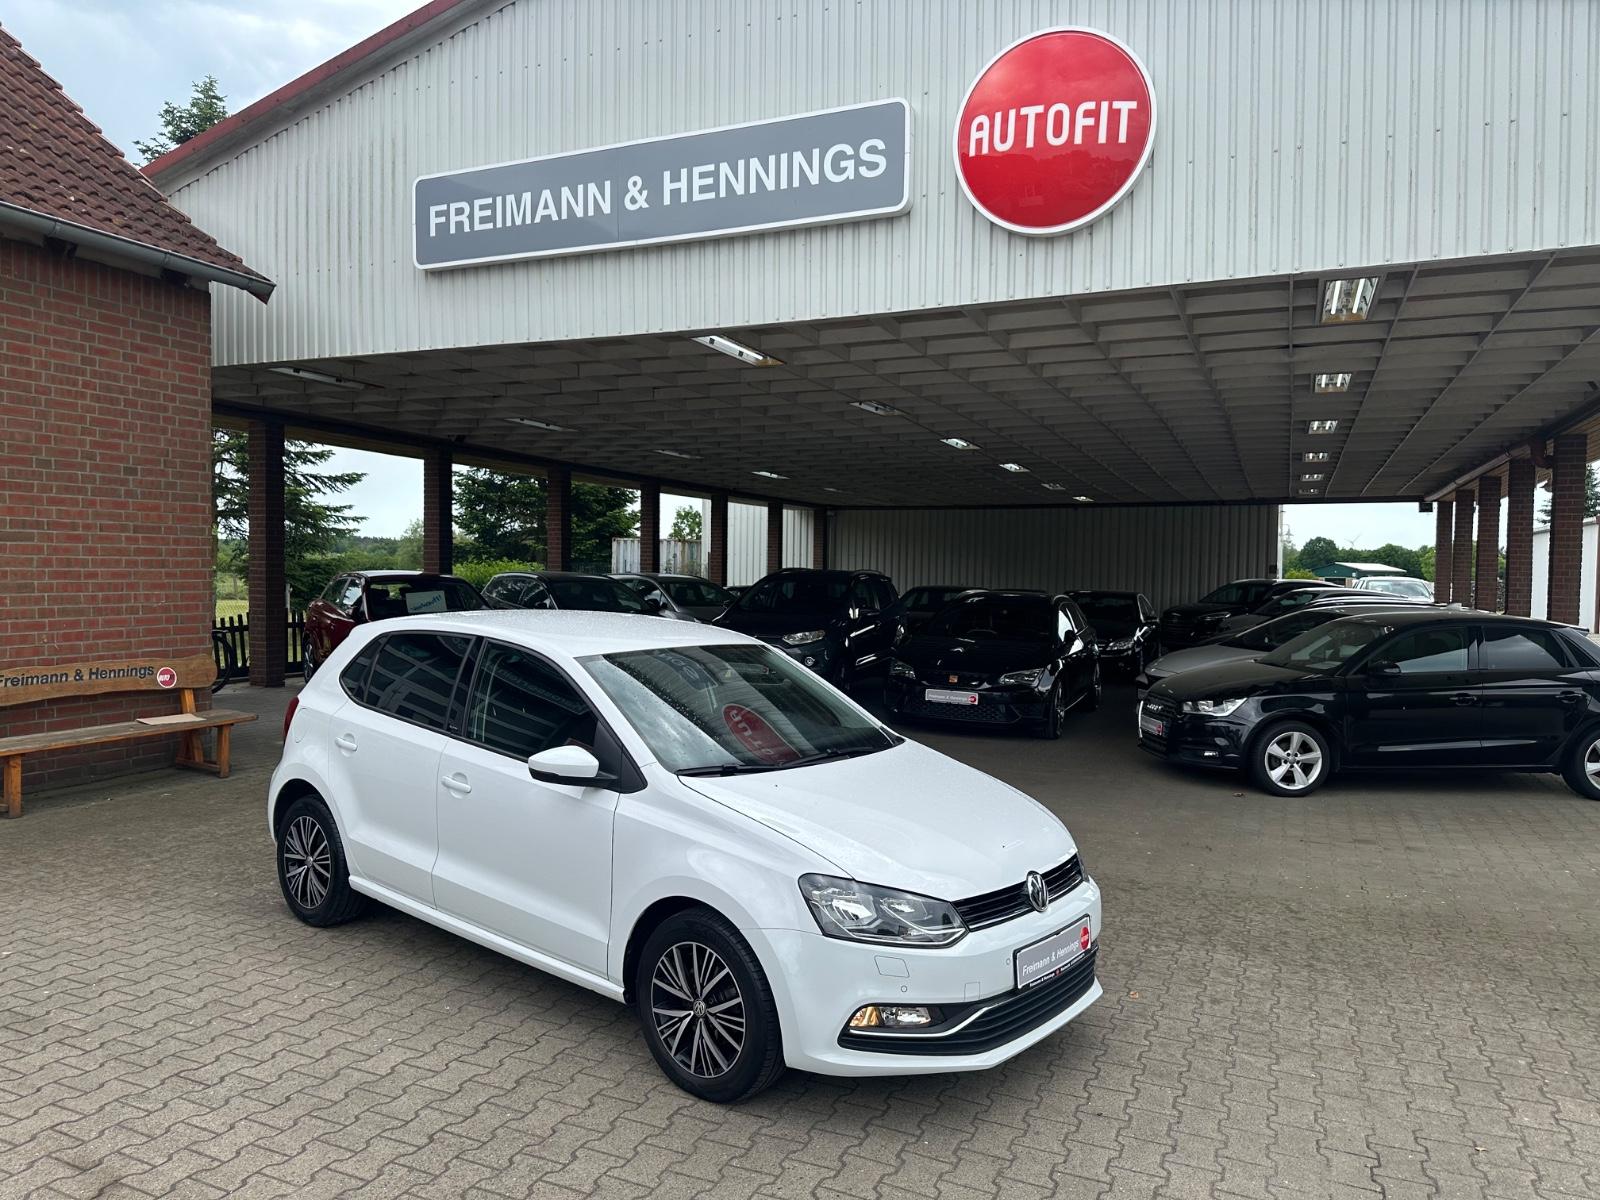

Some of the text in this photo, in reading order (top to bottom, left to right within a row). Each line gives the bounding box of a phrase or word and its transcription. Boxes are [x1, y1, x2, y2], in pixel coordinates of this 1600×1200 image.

[969, 100, 1138, 157] AUTOFIT
[429, 138, 887, 237] FREIMANN & HENNINGS
[74, 668, 84, 681] &
[88, 665, 155, 681] Hennings
[1022, 956, 1050, 977] Freimann
[1051, 951, 1056, 962] &
[1056, 940, 1079, 959] Hennings
